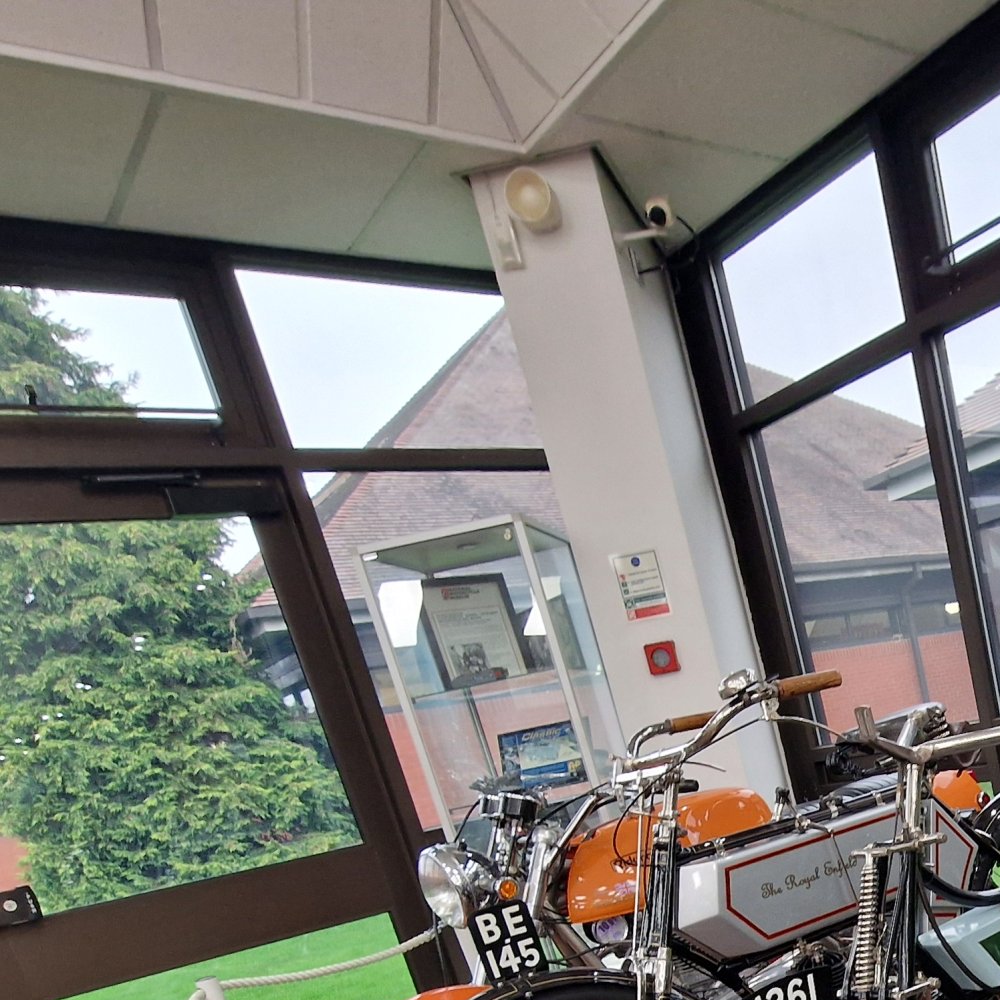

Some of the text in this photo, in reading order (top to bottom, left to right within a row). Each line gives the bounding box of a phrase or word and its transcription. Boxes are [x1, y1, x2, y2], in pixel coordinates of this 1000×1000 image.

[761, 882, 783, 899] The
[785, 866, 820, 889] Royal
[475, 904, 528, 945] BE
[485, 937, 540, 979] 145
